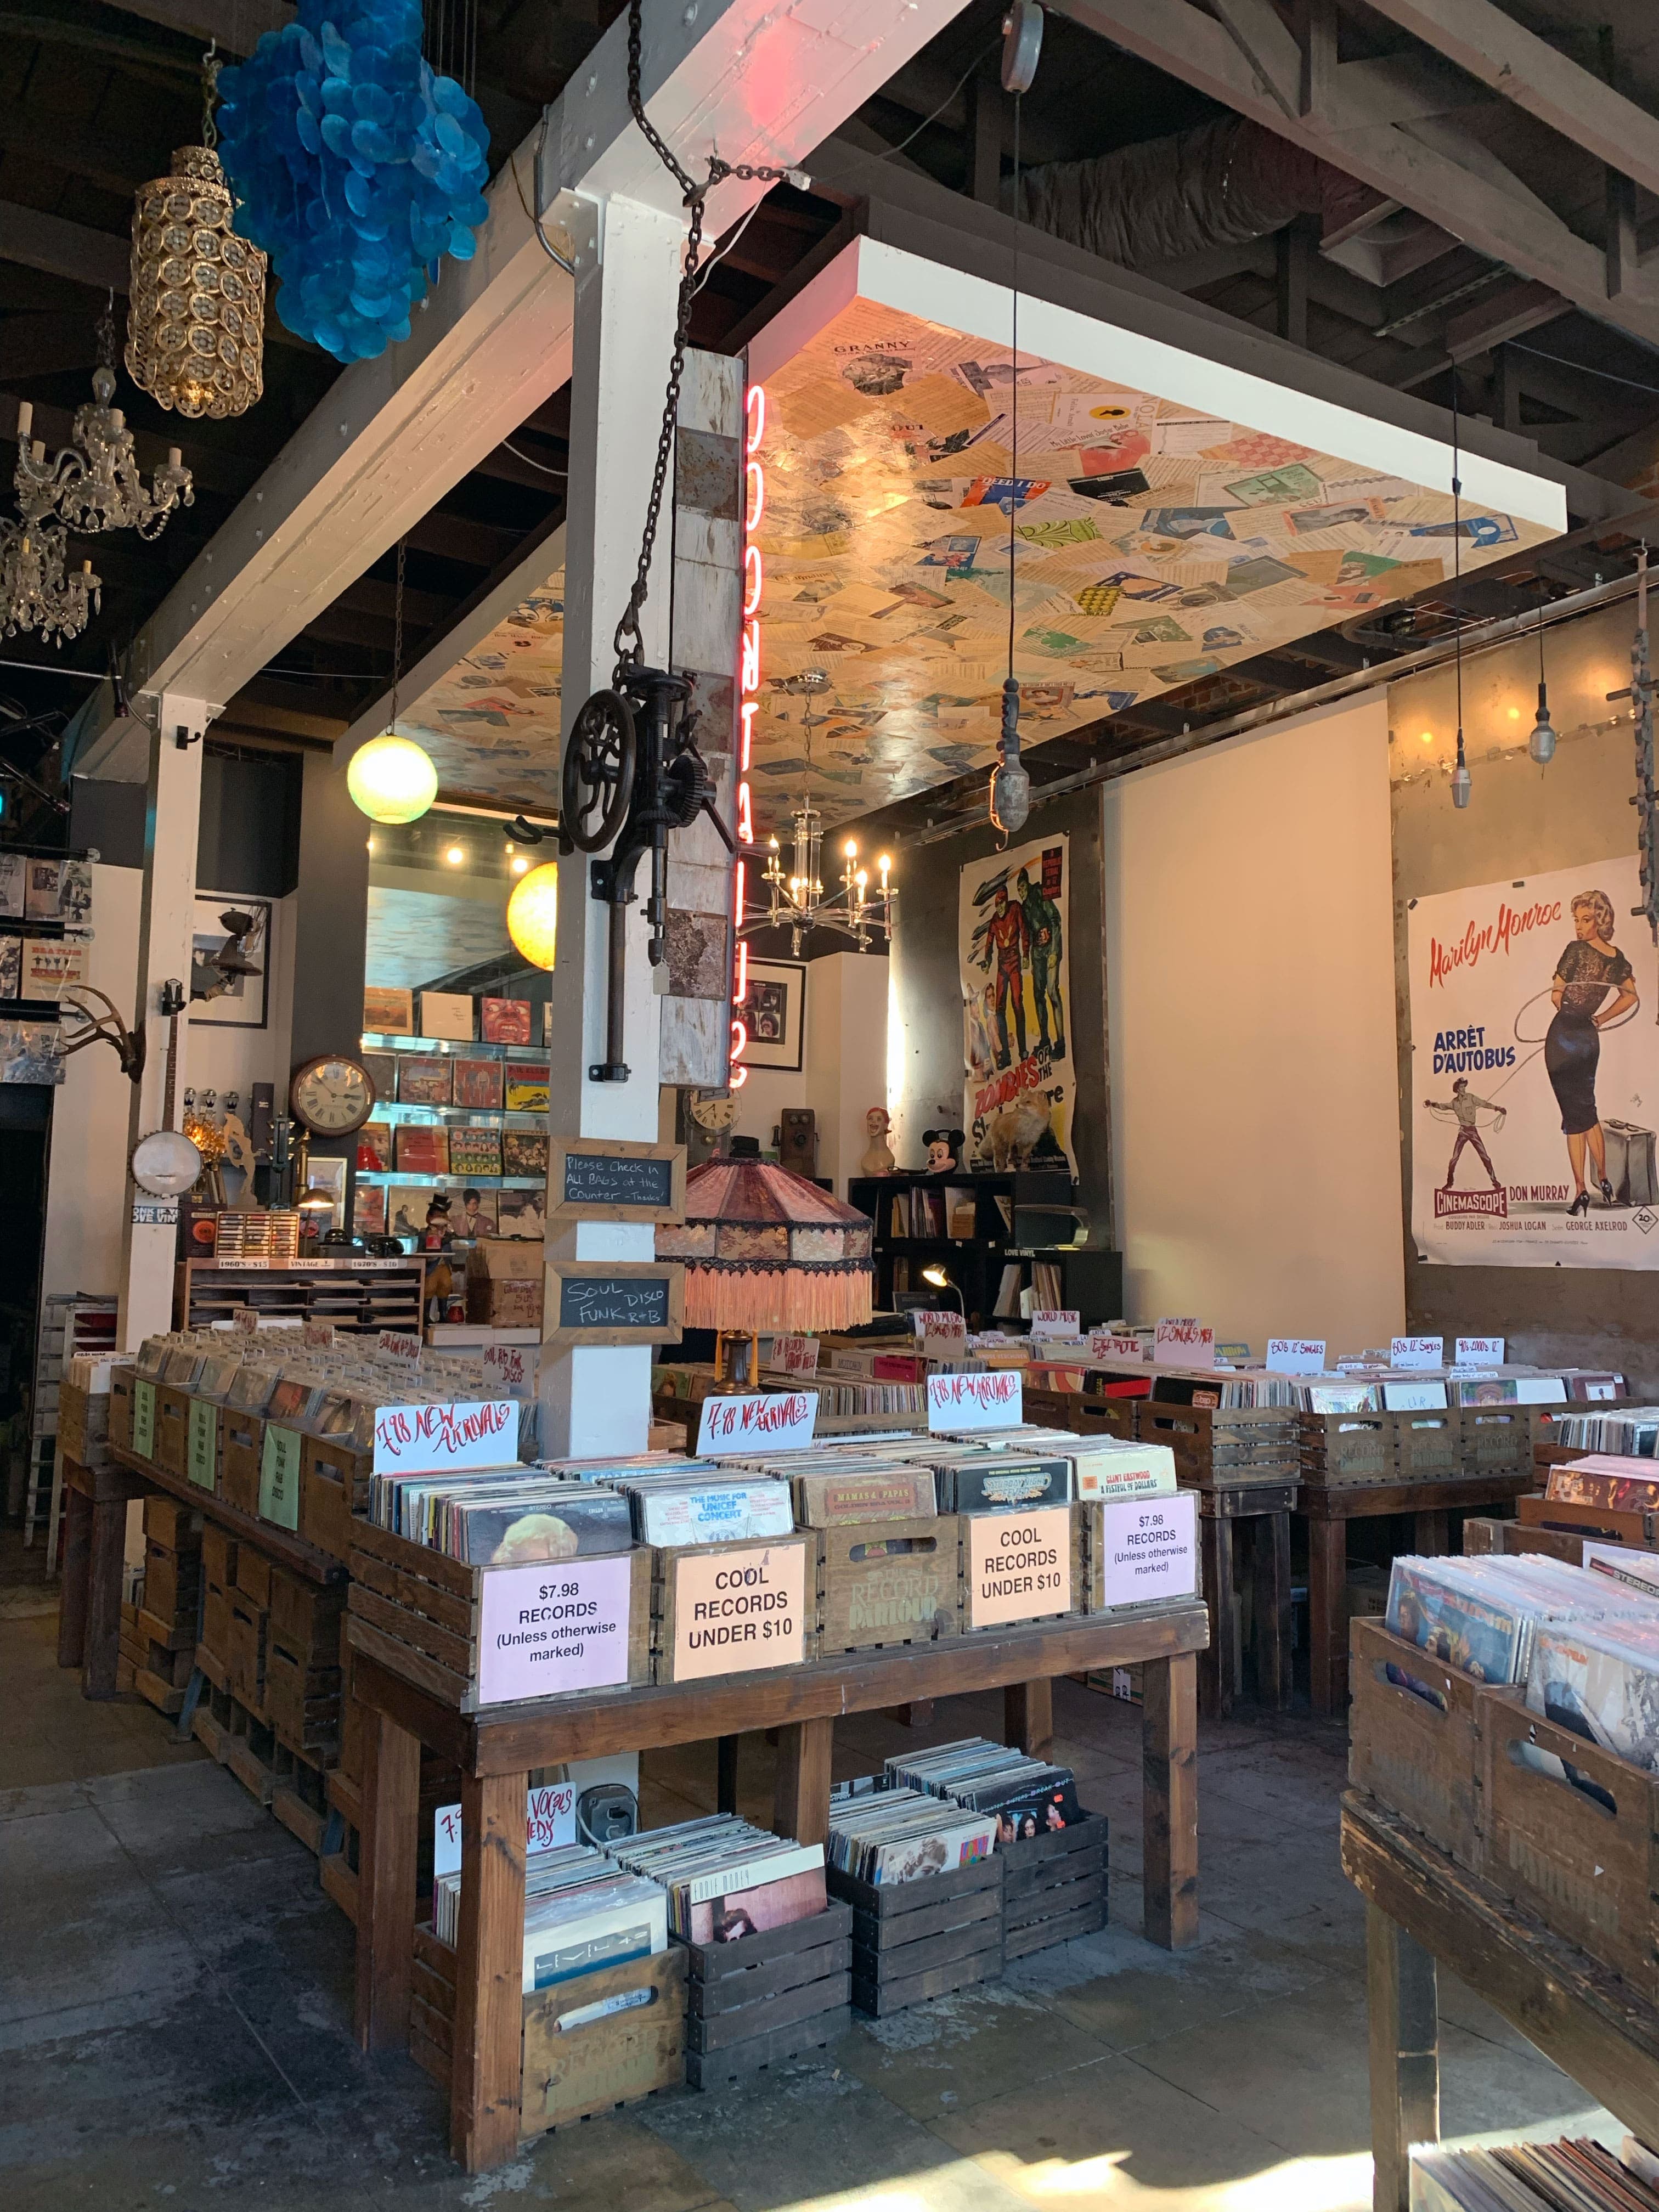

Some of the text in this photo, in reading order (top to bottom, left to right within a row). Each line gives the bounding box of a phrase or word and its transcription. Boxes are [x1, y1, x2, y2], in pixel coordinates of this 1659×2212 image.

[834, 341, 910, 353] GRANNY
[1061, 435, 1077, 446] Little
[1027, 480, 1046, 490] DO
[1430, 901, 1561, 988] Marilyn Monroe
[1434, 1025, 1486, 1053] ARRÊT
[1037, 1045, 1051, 1065] OF
[1432, 1045, 1516, 1075] D'AUTOBUS
[1039, 1062, 1052, 1082] THE
[974, 1055, 1040, 1120] ZOMBIES
[610, 1161, 644, 1173] Check
[566, 1173, 584, 1185] ALL
[589, 1173, 618, 1186] BAGS
[623, 1177, 636, 1187] at
[568, 1187, 622, 1200] Counter
[1436, 1190, 1505, 1215] CINEMASCOPE
[1509, 1185, 1570, 1201] DON MURRAY
[157, 1214, 178, 1223] VIN
[1446, 1221, 1466, 1231] BUDDY
[1466, 1221, 1485, 1231] ADLER
[1499, 1221, 1523, 1231] JOSHUA
[1524, 1221, 1547, 1231] LOGAN
[1566, 1221, 1593, 1231] GEORGE
[1595, 1221, 1628, 1231] AXELROD
[1019, 1249, 1036, 1257] VINYL
[568, 1282, 624, 1302] SOUL
[579, 1301, 626, 1323] FUNK
[1037, 1311, 1077, 1323] WORLD MUSIC
[951, 1374, 977, 1406] NEW
[1106, 1470, 1150, 1485] CLINT EASTWOOD
[690, 1492, 747, 1504] THE MUSIC FOR
[837, 1492, 870, 1502] MAMAS
[882, 1488, 910, 1498] PAPAS
[697, 1509, 742, 1522] CONCERT
[702, 1500, 737, 1511] UNICEF
[1138, 1514, 1164, 1528] $7.98
[1000, 1527, 1042, 1548] COOL
[1127, 1530, 1176, 1546] RECORDS
[984, 1549, 1057, 1574] RECORDS
[1114, 1545, 1188, 1564] (Unless otherwise
[715, 1566, 769, 1590] COOL
[1135, 1561, 1169, 1576] marked)
[539, 1582, 579, 1601] $7.98
[851, 1576, 939, 1607] RECORD
[981, 1572, 1061, 1599] UNDER $10
[518, 1601, 599, 1624] RECORDS
[694, 1590, 788, 1621] RECORDS
[496, 1621, 617, 1650] (Unless otherwise
[689, 1617, 793, 1650] UNDER $10
[529, 1643, 585, 1663] marked)
[694, 1867, 750, 1901] EDDIE MONEY
[536, 1930, 648, 1971] LEVEL 42
